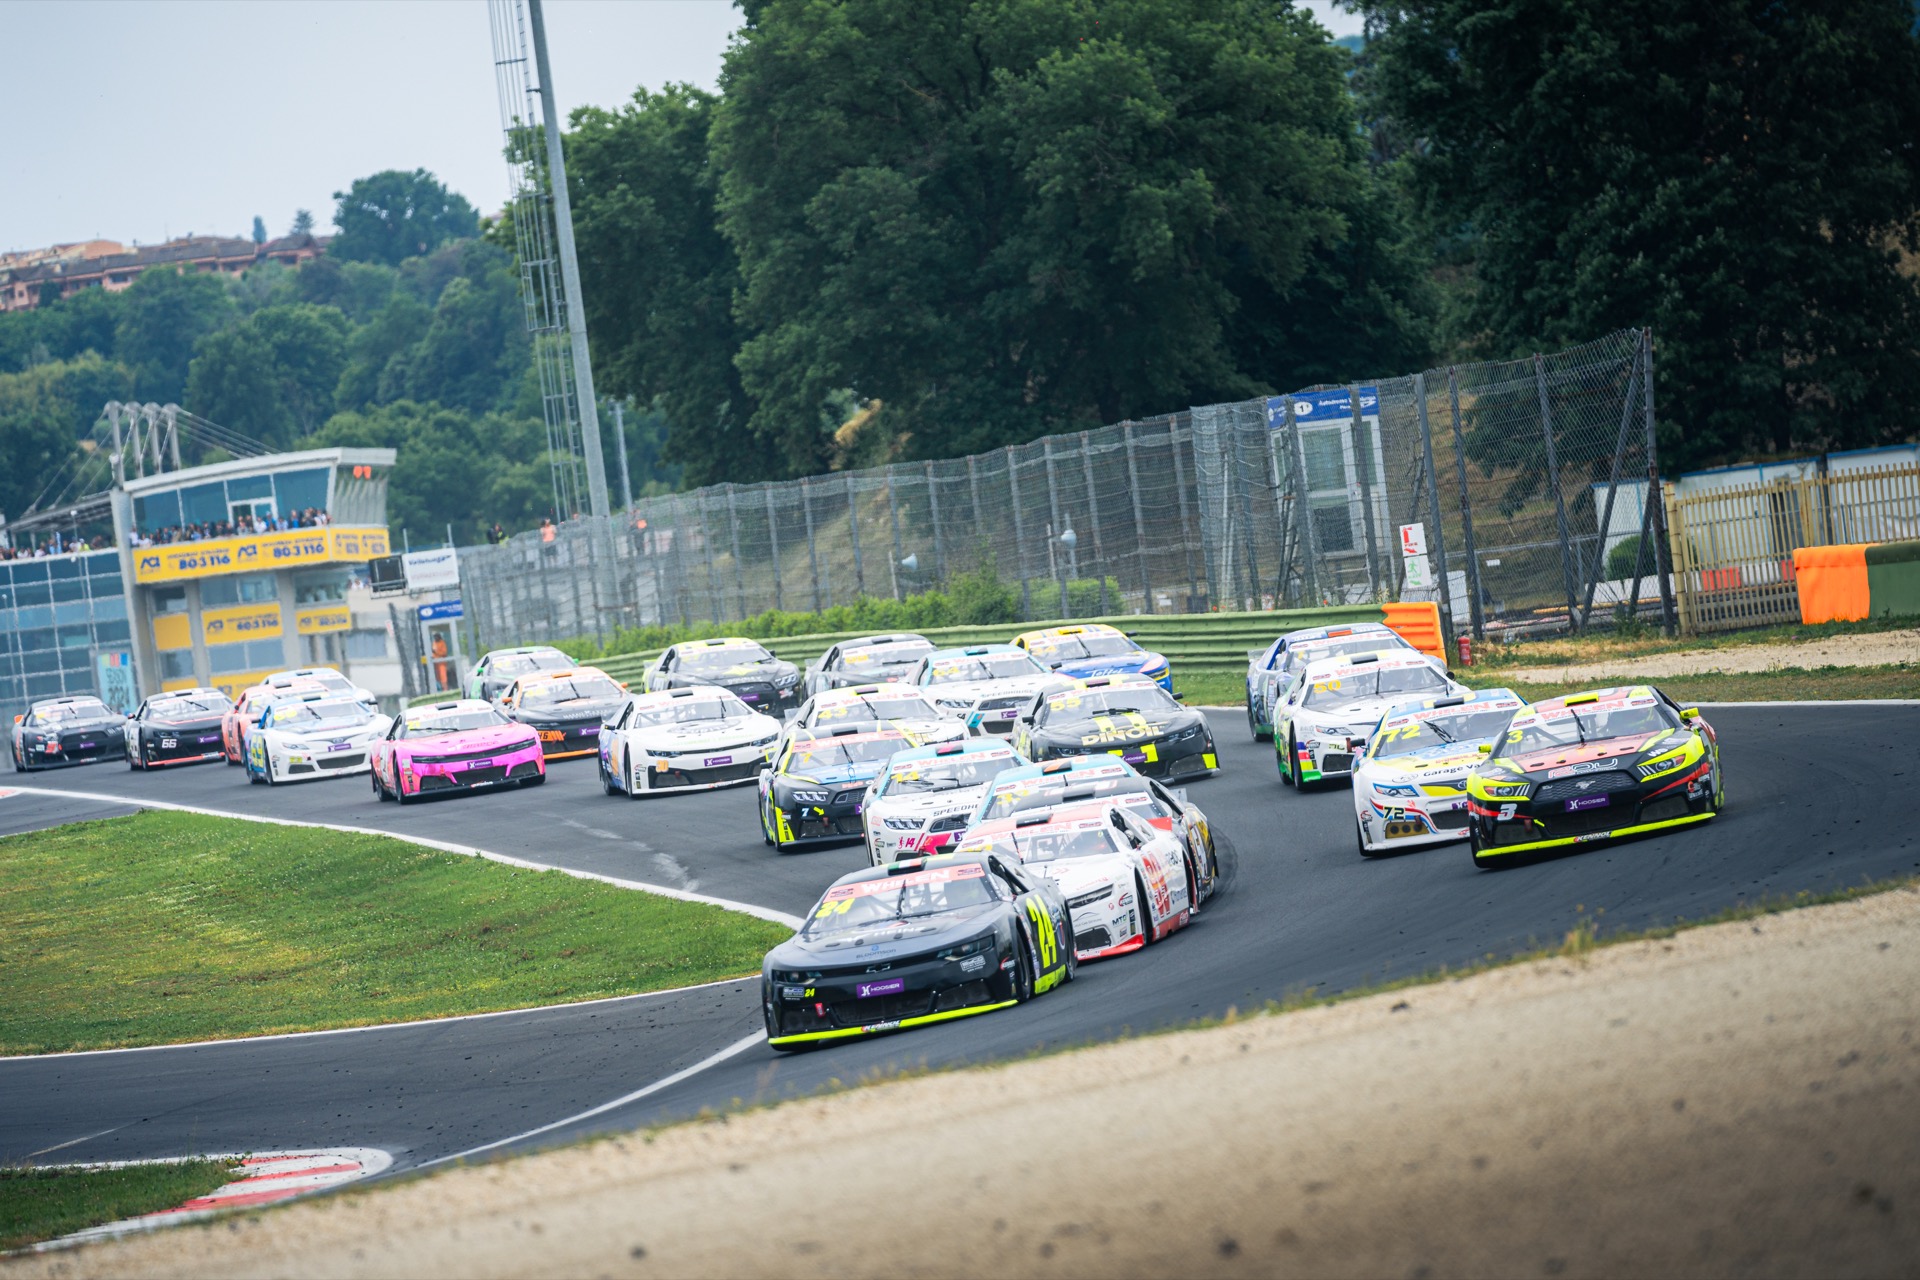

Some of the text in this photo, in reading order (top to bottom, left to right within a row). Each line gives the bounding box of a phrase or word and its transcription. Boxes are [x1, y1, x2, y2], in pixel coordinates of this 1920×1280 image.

[237, 544, 258, 558] ACI
[140, 556, 161, 569] ACI
[1335, 661, 1401, 675] WHELEN
[1313, 680, 1342, 694] 50
[1050, 698, 1081, 711] 55
[1413, 702, 1491, 721] WHELEN
[1541, 701, 1625, 720] WHELEN
[1081, 726, 1164, 746] DINOIL
[1383, 725, 1421, 743] 72
[1506, 730, 1523, 744] 3
[161, 738, 177, 749] 66
[801, 752, 812, 764] 7
[917, 752, 985, 766] WHELEN
[891, 770, 920, 783] 14
[1021, 769, 1096, 787] WHELEN
[1423, 767, 1463, 777] Garage
[1577, 797, 1606, 807] HOOSIER
[802, 807, 810, 817] 7
[1383, 807, 1405, 820] 72
[1496, 803, 1518, 821] 3
[991, 823, 1072, 841] WHELEN
[1576, 831, 1611, 842] KENNOL
[905, 837, 916, 848] 14
[861, 870, 950, 894] WHELEN
[815, 898, 856, 918] 24
[1025, 894, 1057, 969] 24
[856, 948, 896, 959] BLOOMSON
[804, 989, 815, 998] 24
[871, 982, 900, 993] HOOSIER
